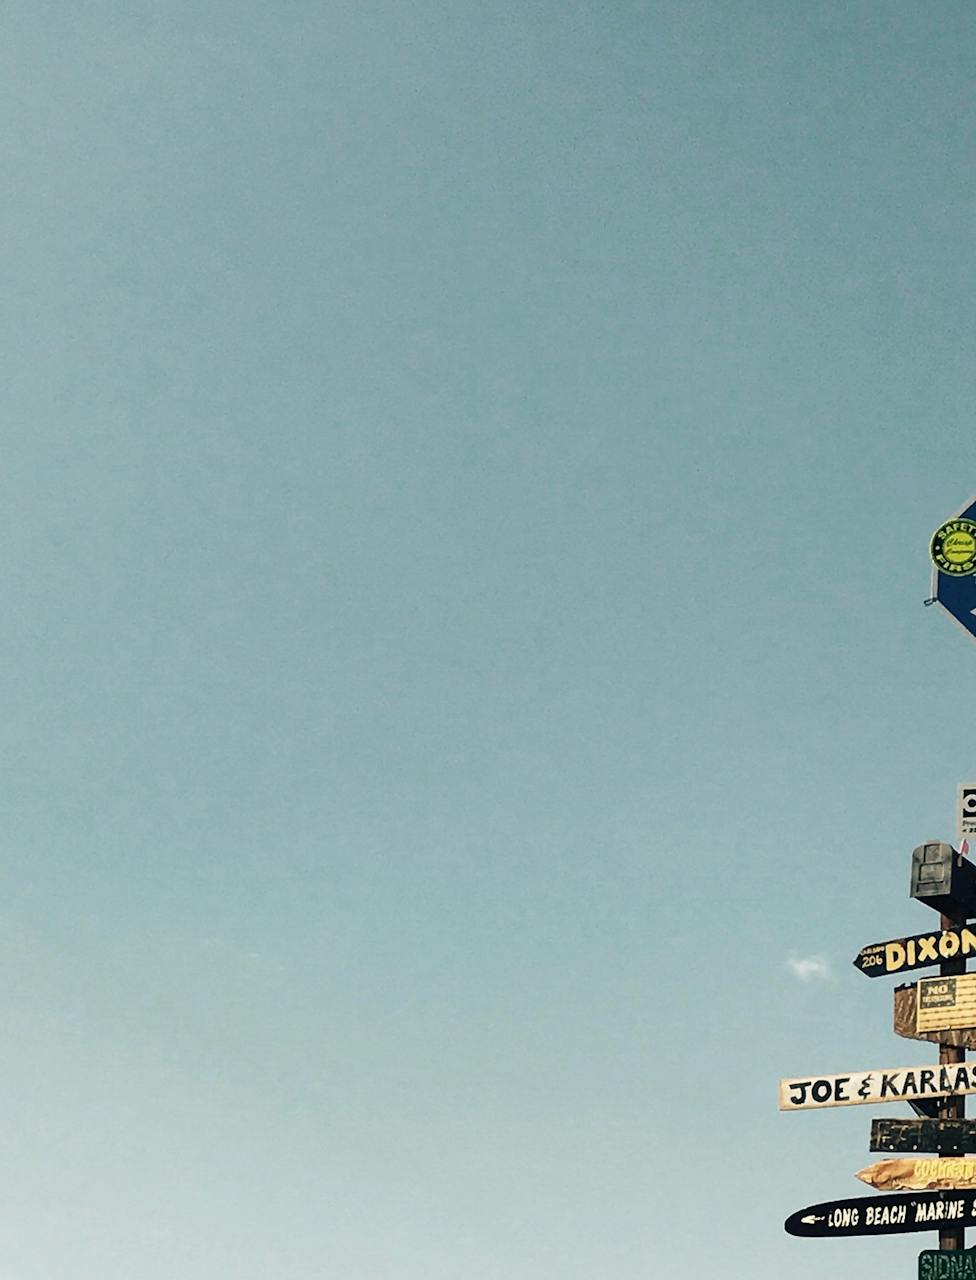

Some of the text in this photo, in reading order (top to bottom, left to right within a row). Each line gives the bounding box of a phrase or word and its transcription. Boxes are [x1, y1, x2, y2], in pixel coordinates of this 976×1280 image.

[862, 954, 883, 968] 206
[928, 984, 948, 994] NO
[789, 1078, 850, 1105] JOE
[828, 1208, 859, 1227] LONG
[866, 1205, 906, 1225] BEACH
